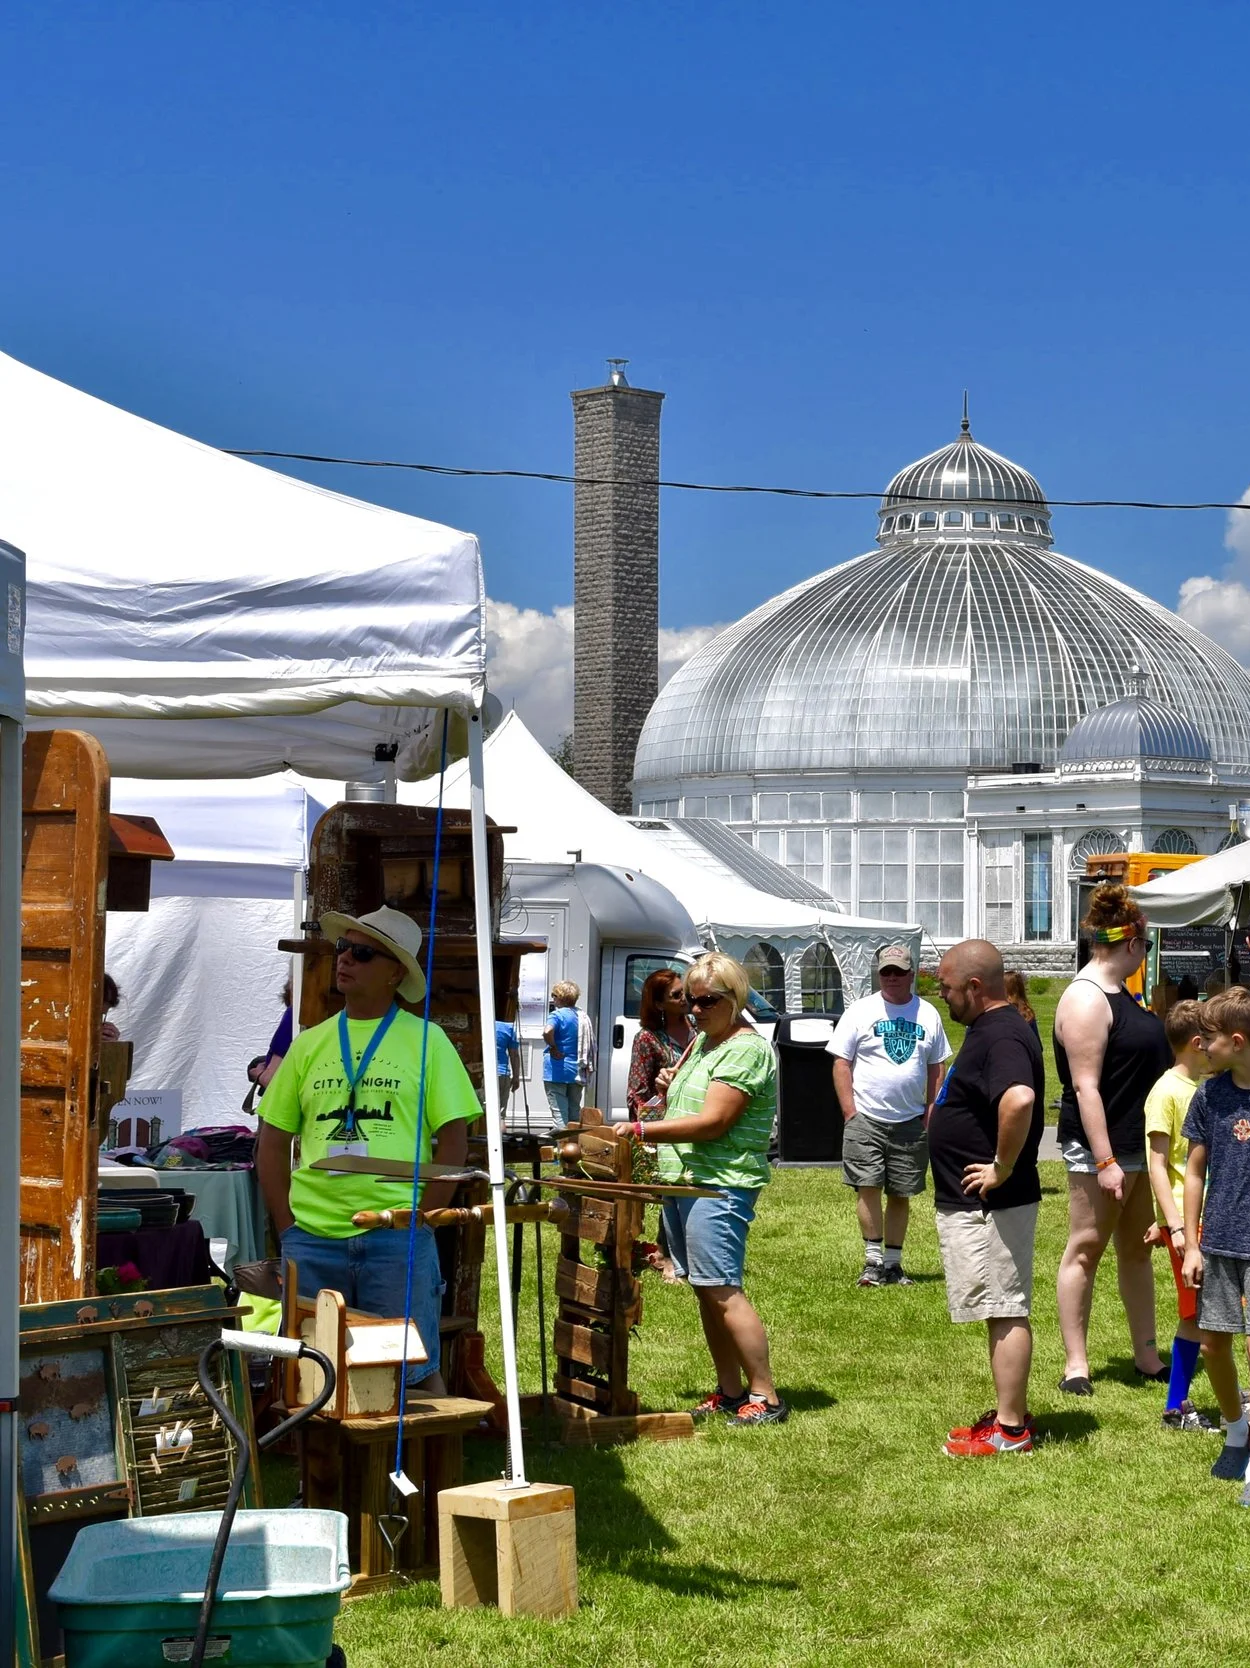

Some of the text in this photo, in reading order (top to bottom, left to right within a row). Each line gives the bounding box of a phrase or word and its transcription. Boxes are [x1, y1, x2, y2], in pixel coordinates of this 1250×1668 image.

[877, 1020, 922, 1036] BUFFALO
[891, 1039, 908, 1054] PAL
[313, 1078, 344, 1090] CITY
[361, 1077, 401, 1089] NIGHT
[133, 1096, 163, 1106] NOW!
